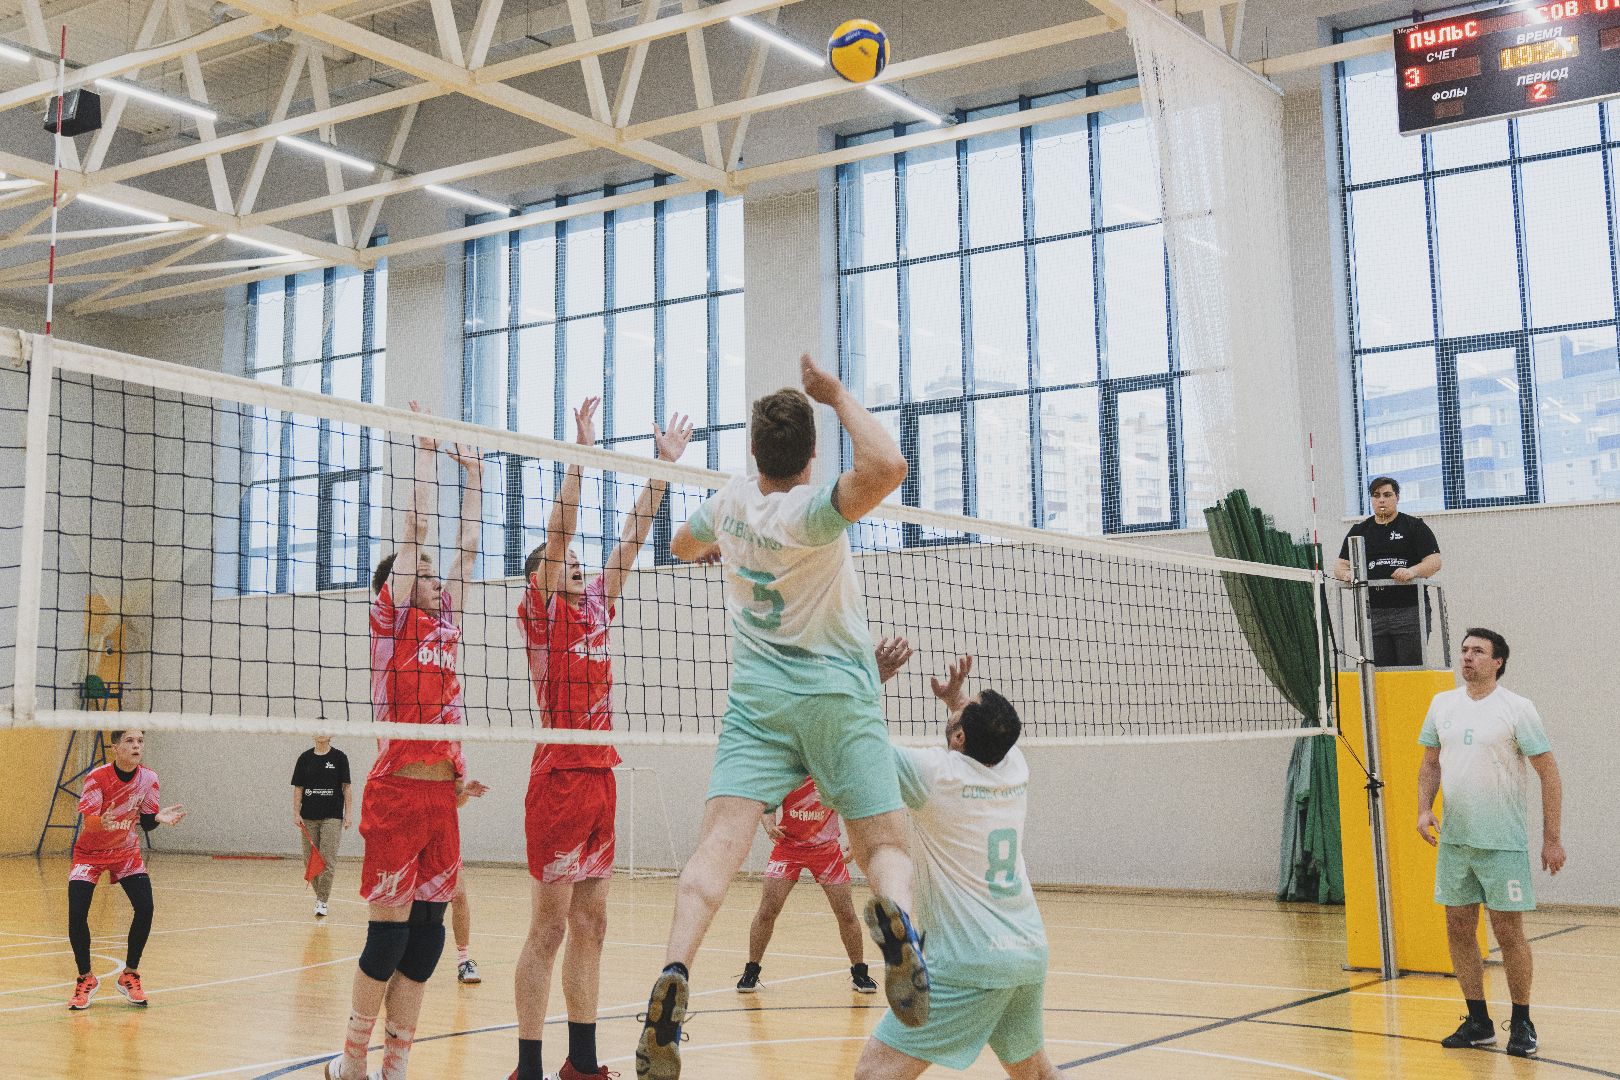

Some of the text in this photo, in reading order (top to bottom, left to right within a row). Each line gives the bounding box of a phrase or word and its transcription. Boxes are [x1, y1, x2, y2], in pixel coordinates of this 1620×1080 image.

[1409, 20, 1478, 49] ПУЛЬС
[1516, 26, 1563, 45] ВРЕМЯ
[1426, 47, 1458, 63] СЧЕТ
[1404, 67, 1421, 88] 3
[1516, 66, 1569, 87] ПЕРИОД
[1431, 86, 1469, 102] ФОЛЫ
[1533, 83, 1548, 100] 2
[735, 565, 786, 632] 5
[1463, 728, 1474, 746] 6
[984, 827, 1023, 900] 8
[1507, 879, 1523, 902] 6
